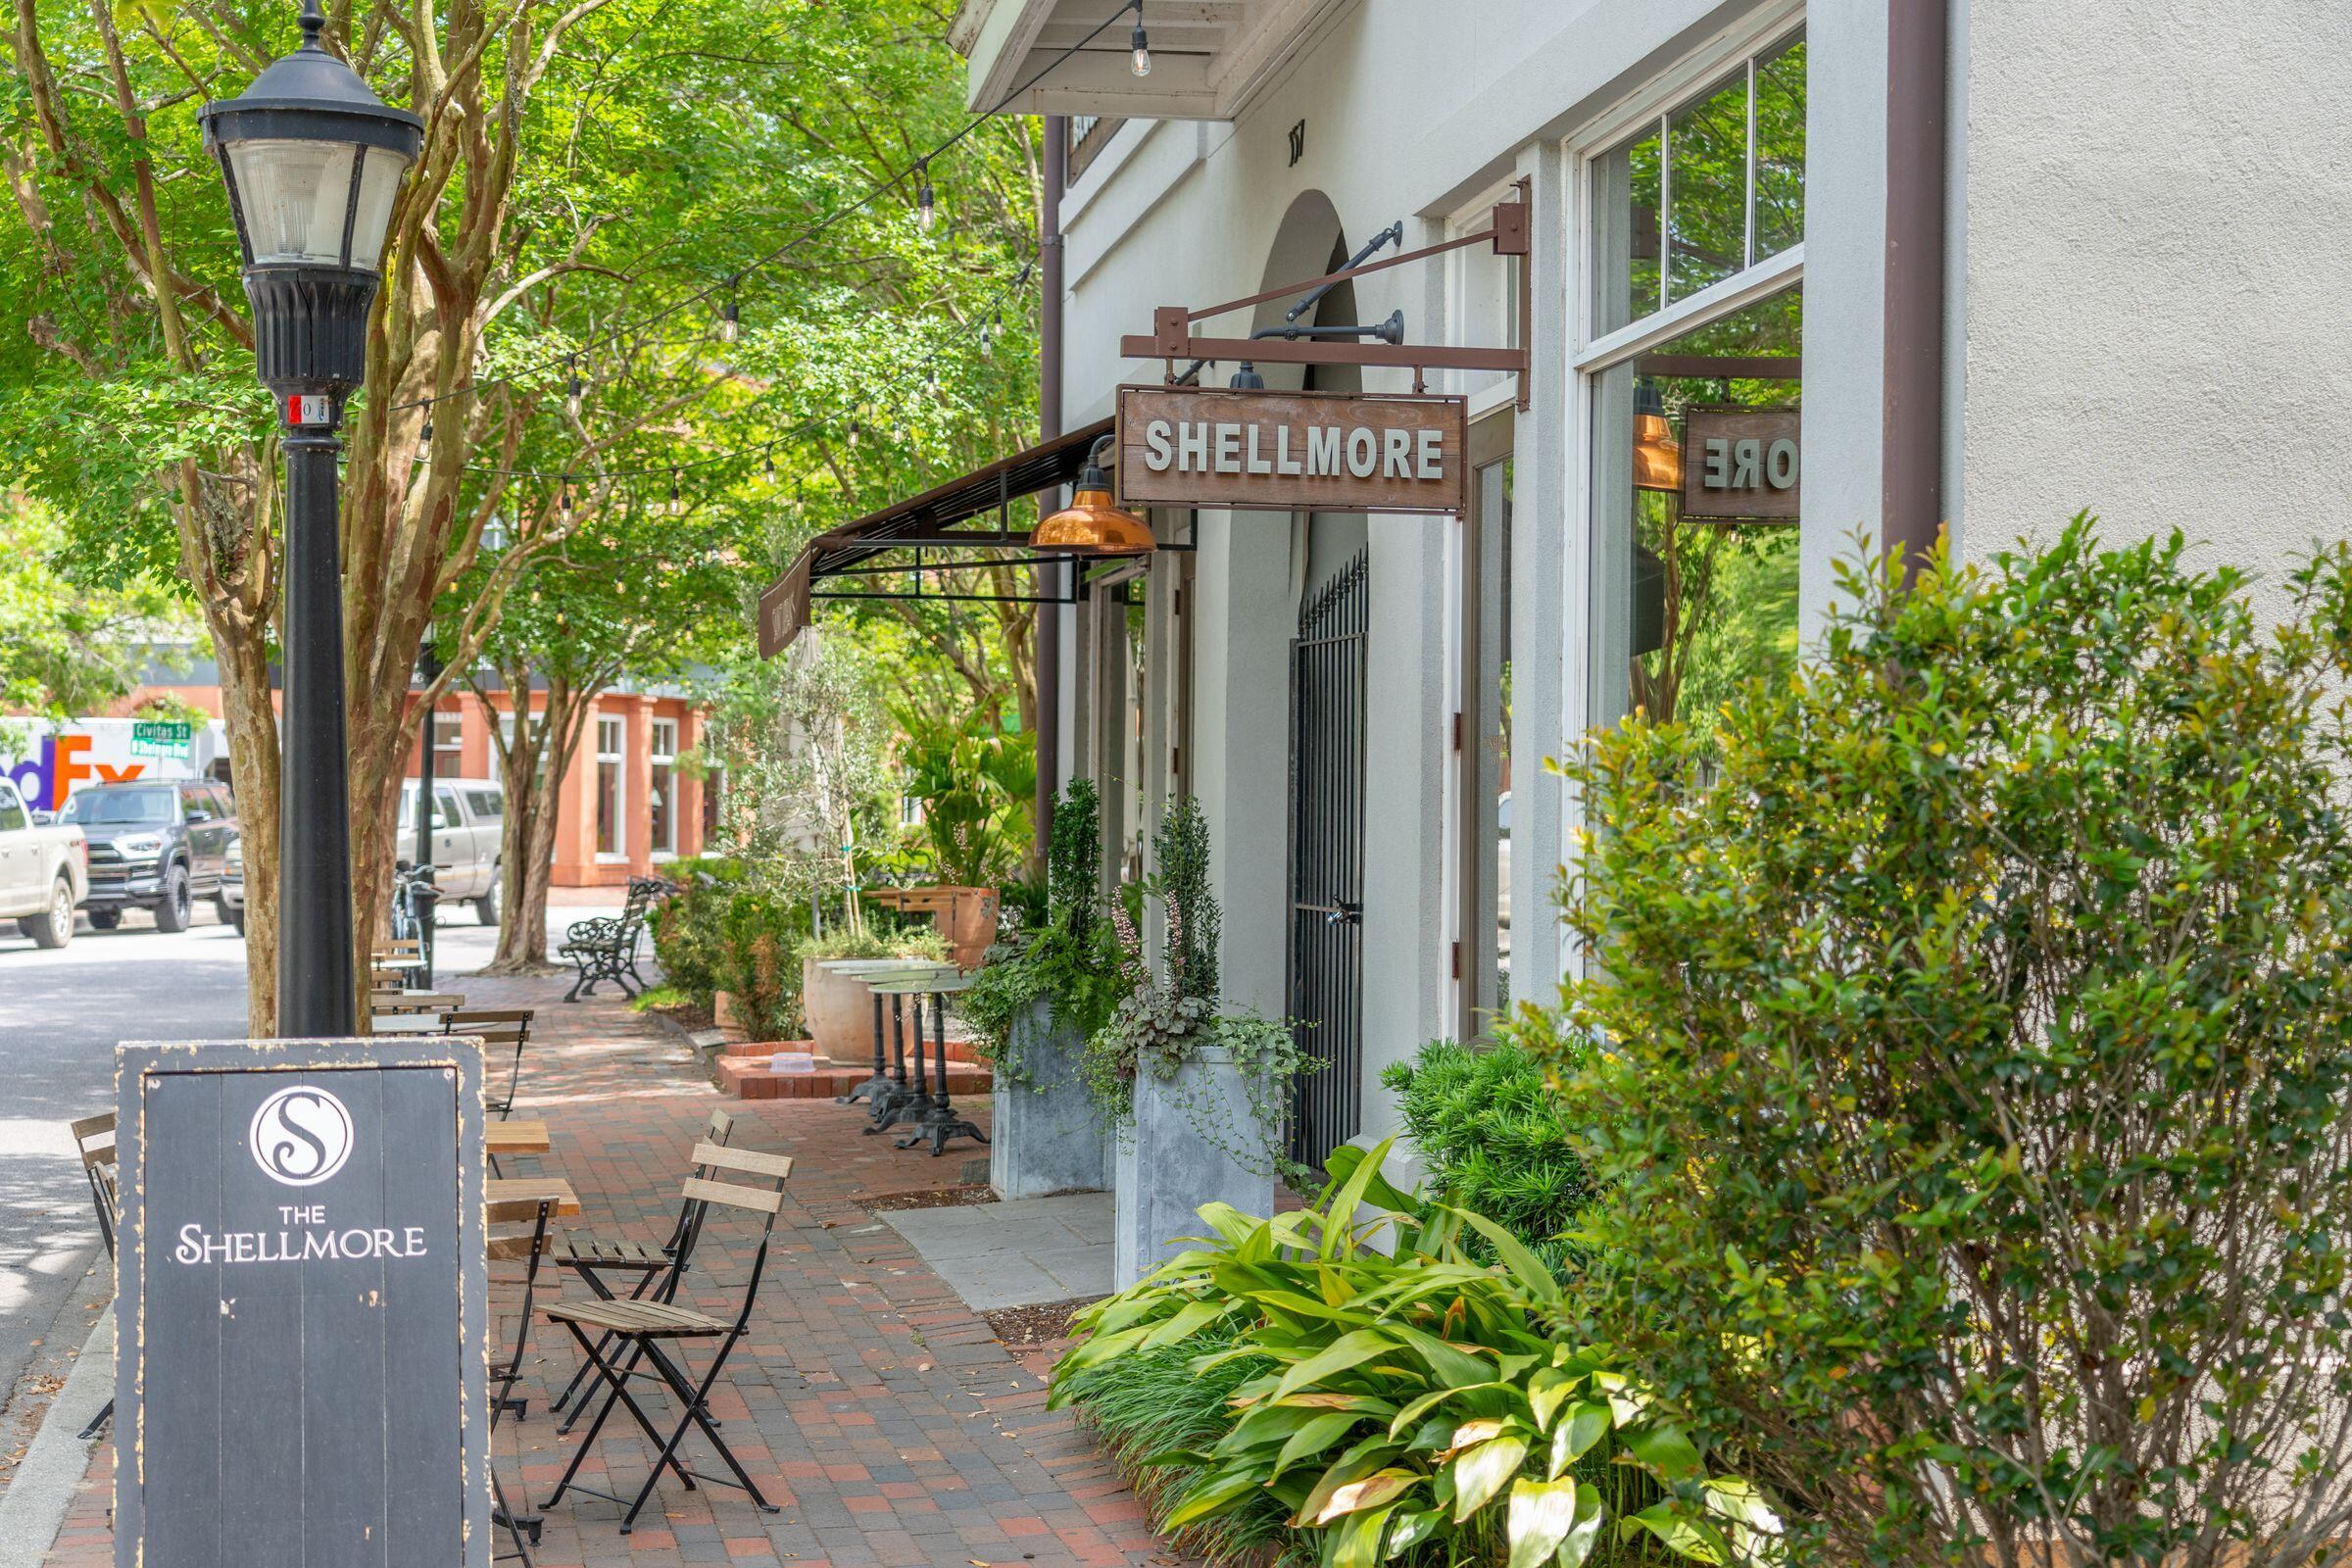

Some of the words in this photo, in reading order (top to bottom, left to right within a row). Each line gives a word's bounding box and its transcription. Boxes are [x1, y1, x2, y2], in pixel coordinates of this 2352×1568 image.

[1145, 419, 1443, 479] SHELLMORE
[136, 723, 173, 738] Civitas
[176, 724, 187, 739] St
[272, 1091, 326, 1180] S
[278, 1205, 325, 1225] THE
[175, 1223, 427, 1264] SHELLMORE
